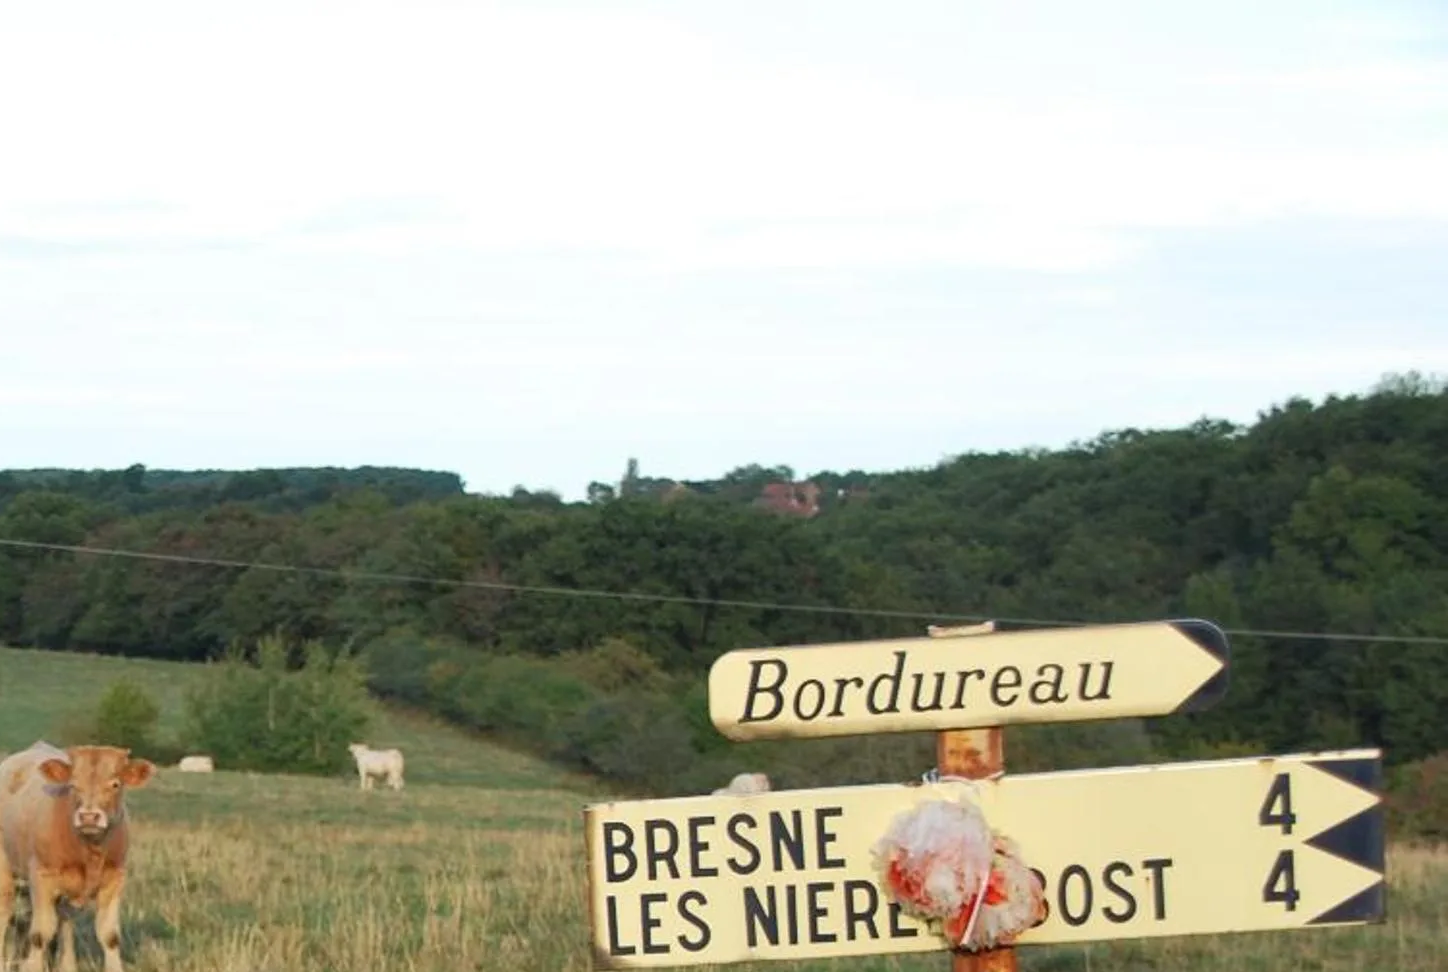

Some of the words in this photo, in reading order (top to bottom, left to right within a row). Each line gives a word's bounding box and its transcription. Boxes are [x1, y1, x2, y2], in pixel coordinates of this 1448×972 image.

[737, 650, 1115, 724] Bordureau
[602, 806, 847, 883] BRESNE
[1258, 771, 1297, 835] 4
[605, 889, 712, 956] LES
[1262, 848, 1301, 912] 4
